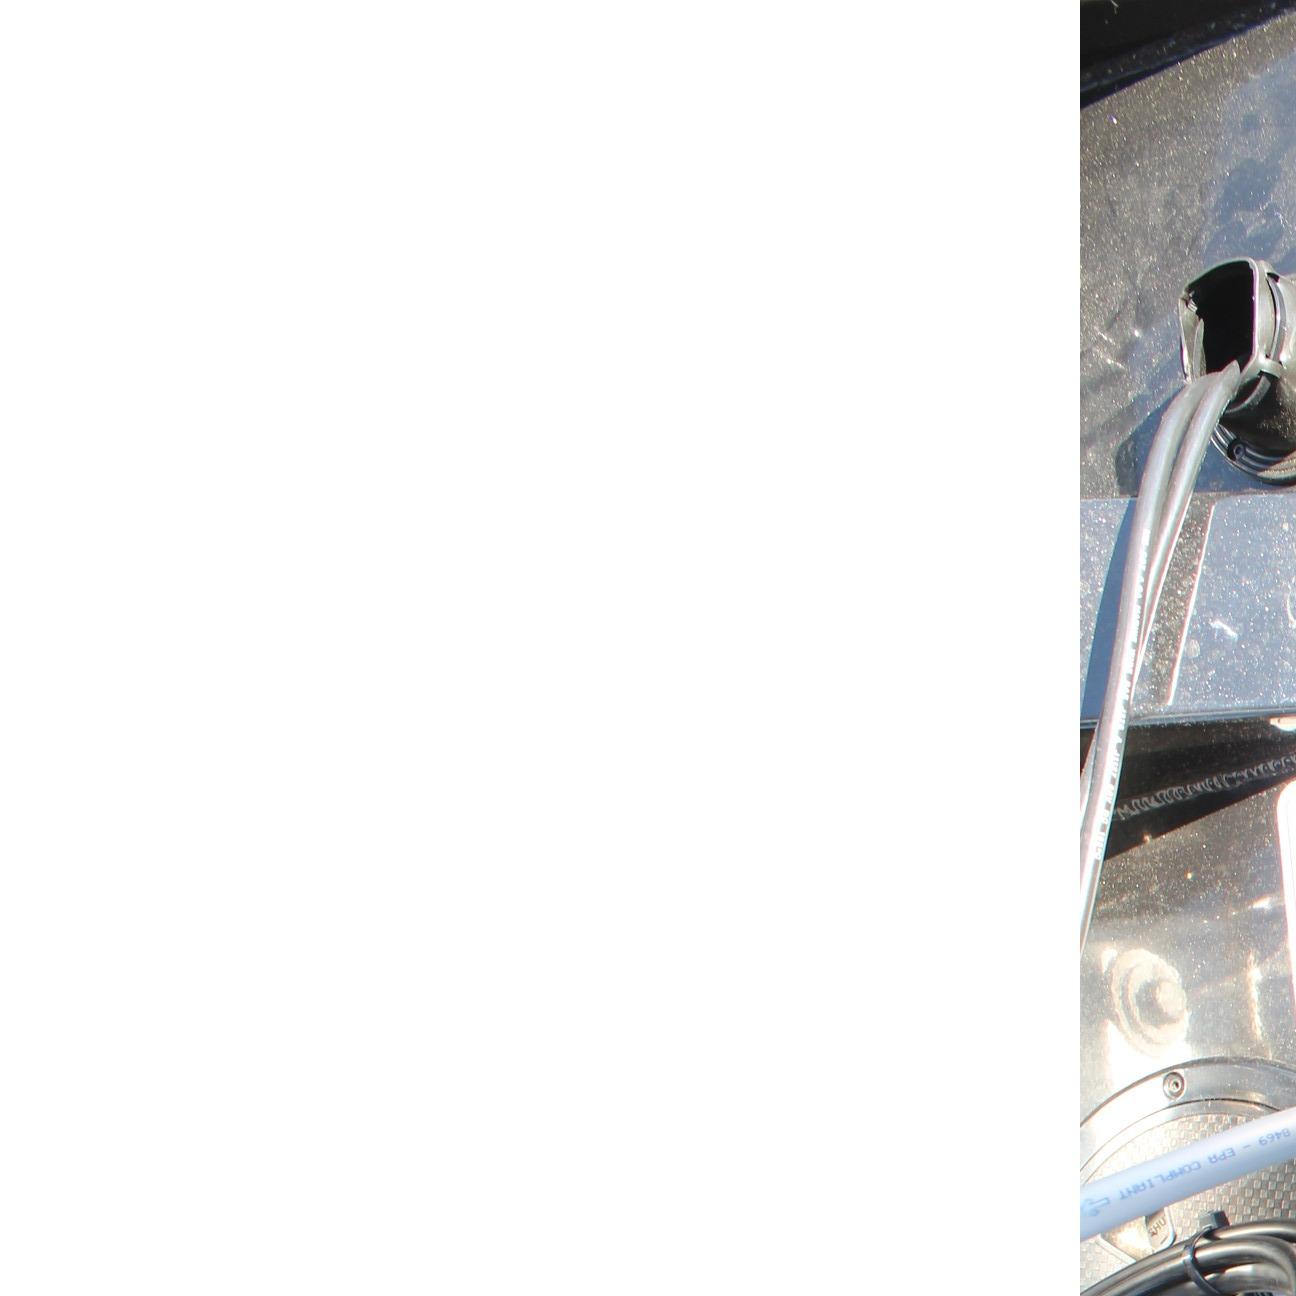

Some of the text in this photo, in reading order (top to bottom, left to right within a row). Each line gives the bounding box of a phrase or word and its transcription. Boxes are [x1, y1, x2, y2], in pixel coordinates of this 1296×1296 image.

[1255, 1125, 1292, 1148] 8469
[1205, 1145, 1237, 1167] EPA
[1114, 1158, 1205, 1203] COMPLIANT
